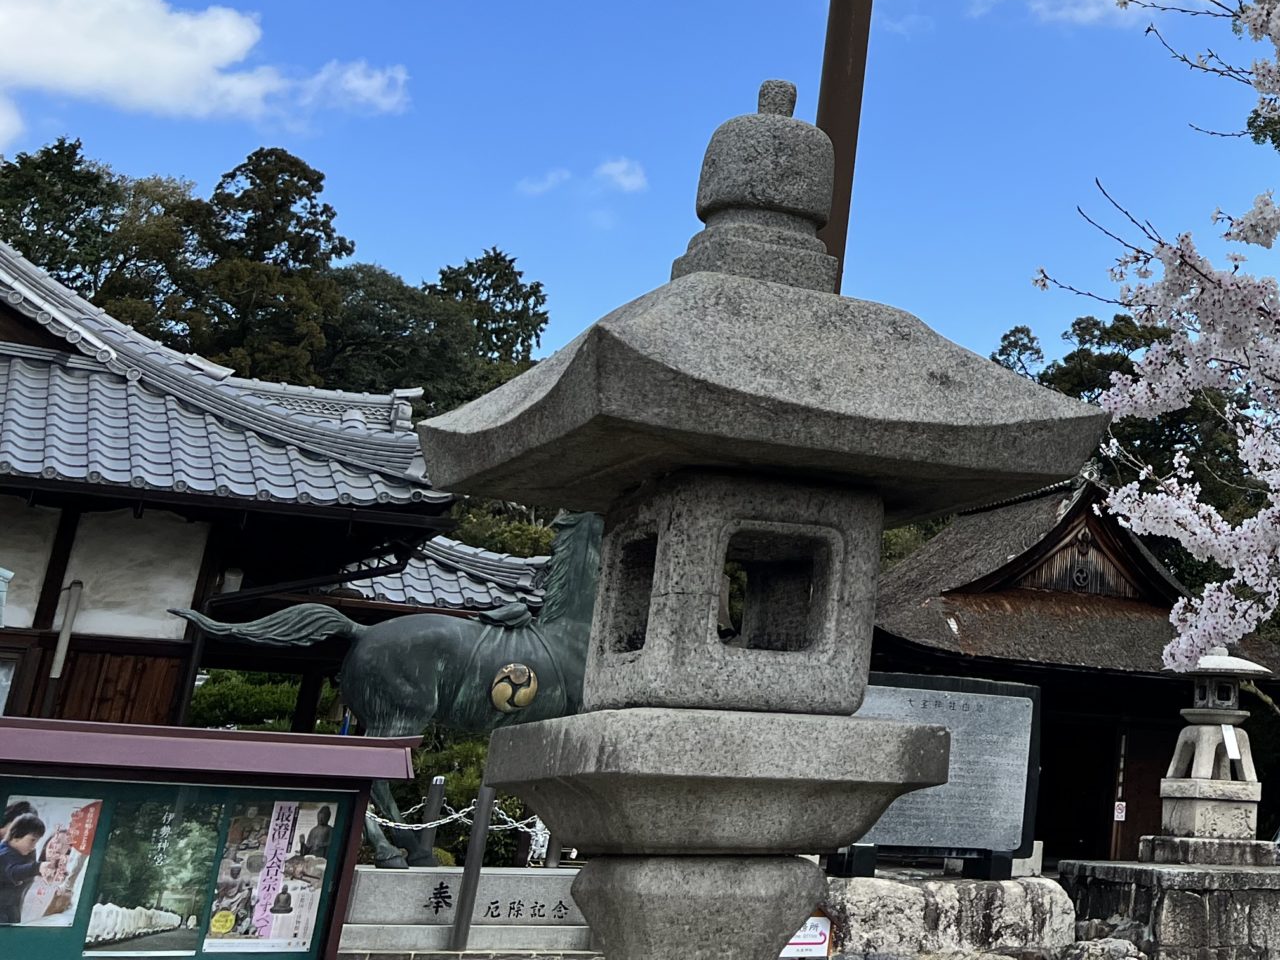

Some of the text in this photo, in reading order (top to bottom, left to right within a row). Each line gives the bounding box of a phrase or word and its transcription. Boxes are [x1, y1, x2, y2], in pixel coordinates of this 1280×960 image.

[256, 806, 292, 936] 最澄と天台宗のすべて
[423, 881, 452, 915] 奉
[484, 900, 570, 919] 厄除記念
